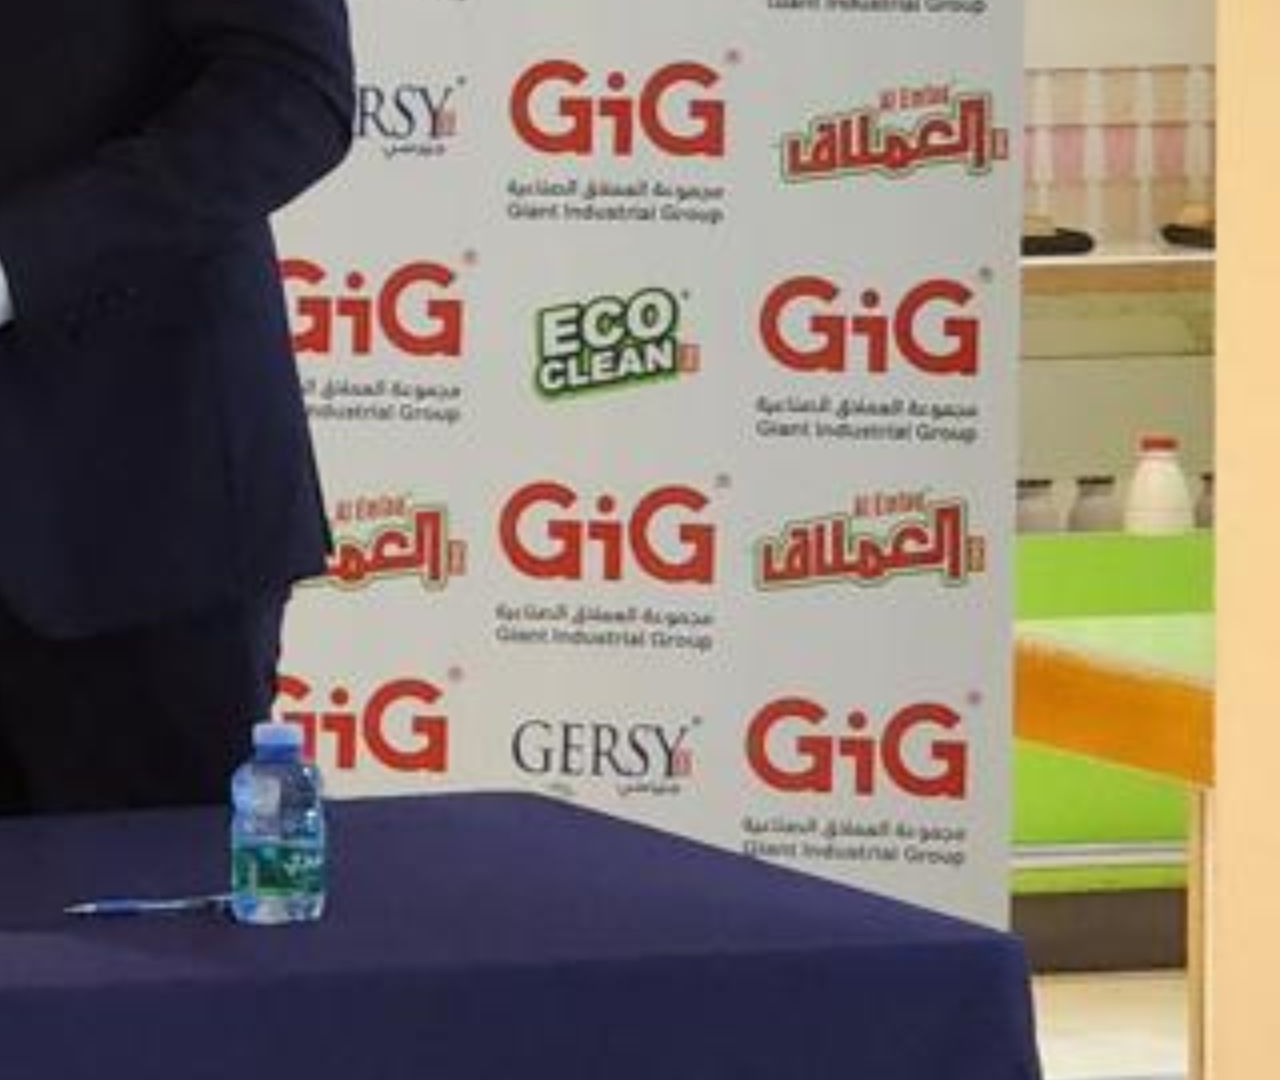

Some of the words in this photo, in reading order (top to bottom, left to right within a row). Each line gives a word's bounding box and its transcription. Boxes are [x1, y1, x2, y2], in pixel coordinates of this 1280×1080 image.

[357, 85, 453, 138] RSY
[510, 60, 726, 159] GiG
[508, 203, 560, 220] Giant
[564, 204, 656, 221] Industrial
[661, 203, 724, 224] Group
[540, 290, 675, 353] ECO
[758, 275, 980, 376] GiG
[540, 340, 674, 390] CLEAN
[306, 405, 395, 420] ndustrial
[400, 403, 460, 423] Group
[756, 420, 810, 437] Giant
[816, 422, 912, 440] Industrial
[916, 422, 977, 443] Group
[497, 480, 716, 584] GiG
[496, 626, 549, 642] Giant
[552, 629, 645, 648] Industrial
[651, 631, 712, 652] Group
[511, 718, 689, 777] GERSY
[745, 696, 968, 800] GiG
[743, 840, 796, 858] Giant
[801, 844, 899, 861] Industrial
[903, 845, 965, 867] Group
